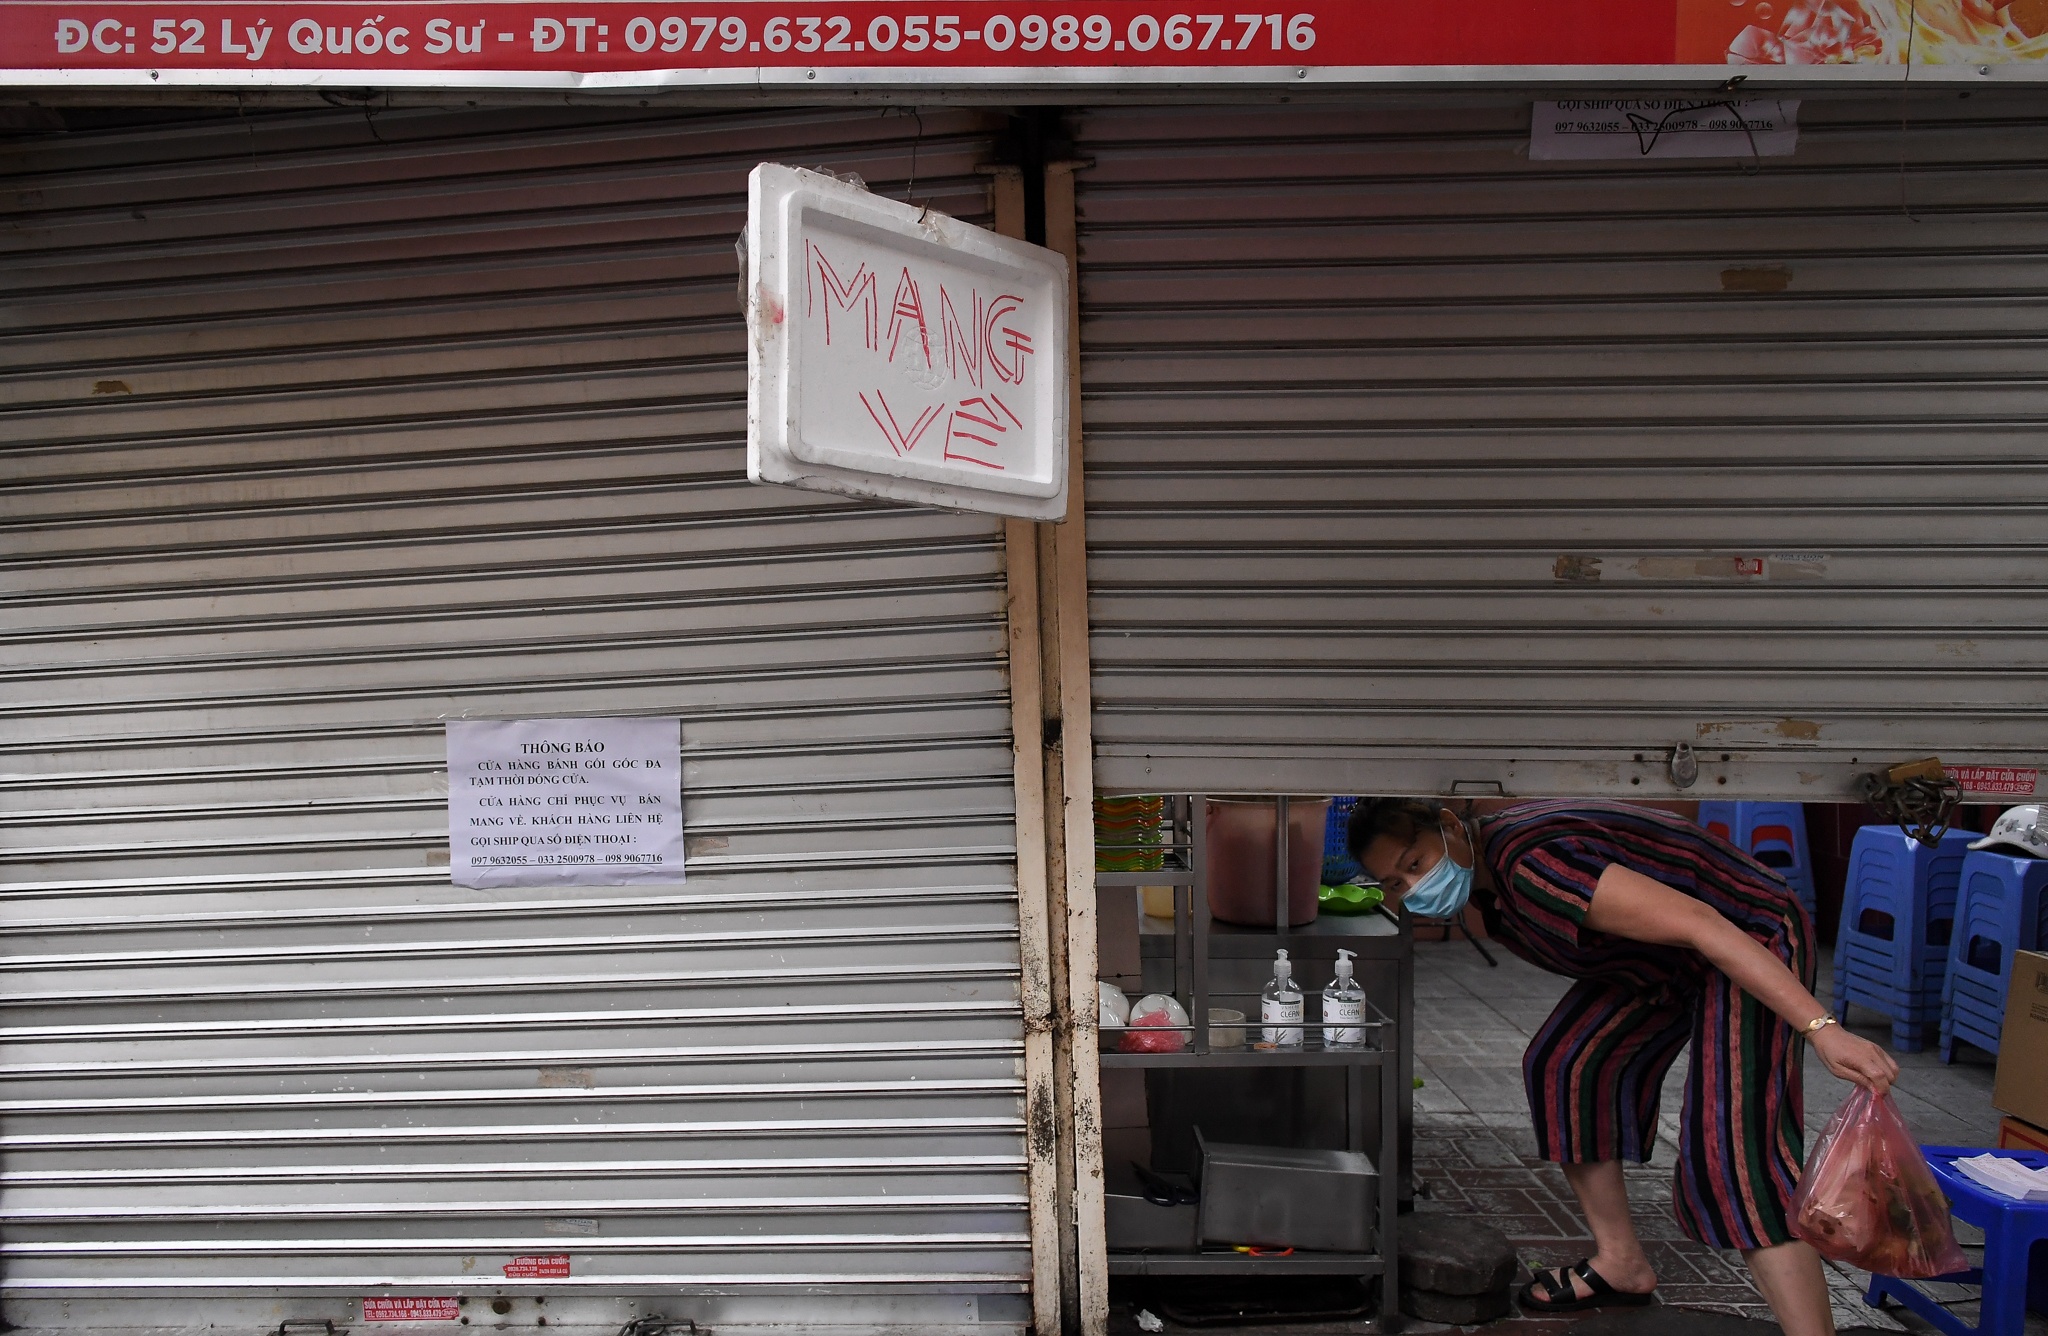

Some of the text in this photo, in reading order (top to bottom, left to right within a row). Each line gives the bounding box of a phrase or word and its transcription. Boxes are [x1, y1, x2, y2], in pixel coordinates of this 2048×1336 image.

[55, 13, 1316, 60] ĐC: 52 Lý Quốc Sư - ĐT: 0979.632.055-0989.067.716
[1555, 121, 1574, 132] 097
[1577, 121, 1620, 132] 9632055
[1709, 120, 1727, 131] 098
[805, 238, 1034, 390] MANG
[521, 739, 605, 754] THÔNG BÁO
[508, 759, 540, 770] HÀNG
[547, 758, 578, 770] BÁNH
[645, 759, 661, 769] ĐA
[469, 776, 494, 787] TẠM
[497, 774, 524, 785] THỜI
[527, 774, 560, 785] ĐÓNG
[509, 795, 541, 806] HÀNG
[547, 794, 568, 806] CHỈ
[574, 795, 605, 807] PHỤC
[611, 795, 627, 806] VỤ
[639, 793, 661, 805] BÁN
[470, 816, 503, 827] MANG
[532, 814, 573, 825] KHÁCH
[578, 814, 611, 825] HÀNG
[616, 813, 642, 824] LIÊN
[647, 813, 664, 825] HỆ
[470, 836, 491, 847] GỌI
[493, 836, 519, 846] SHIP
[521, 836, 545, 846] QUA
[564, 834, 592, 846] ĐIỆN
[594, 834, 630, 845] THOẠI
[471, 856, 487, 865] 097
[490, 855, 528, 865] 9632055
[537, 855, 554, 864] 033
[557, 854, 595, 864] 2500978
[605, 854, 622, 863] 098
[624, 853, 663, 863] 9067716
[1280, 1010, 1300, 1018] CLEAN
